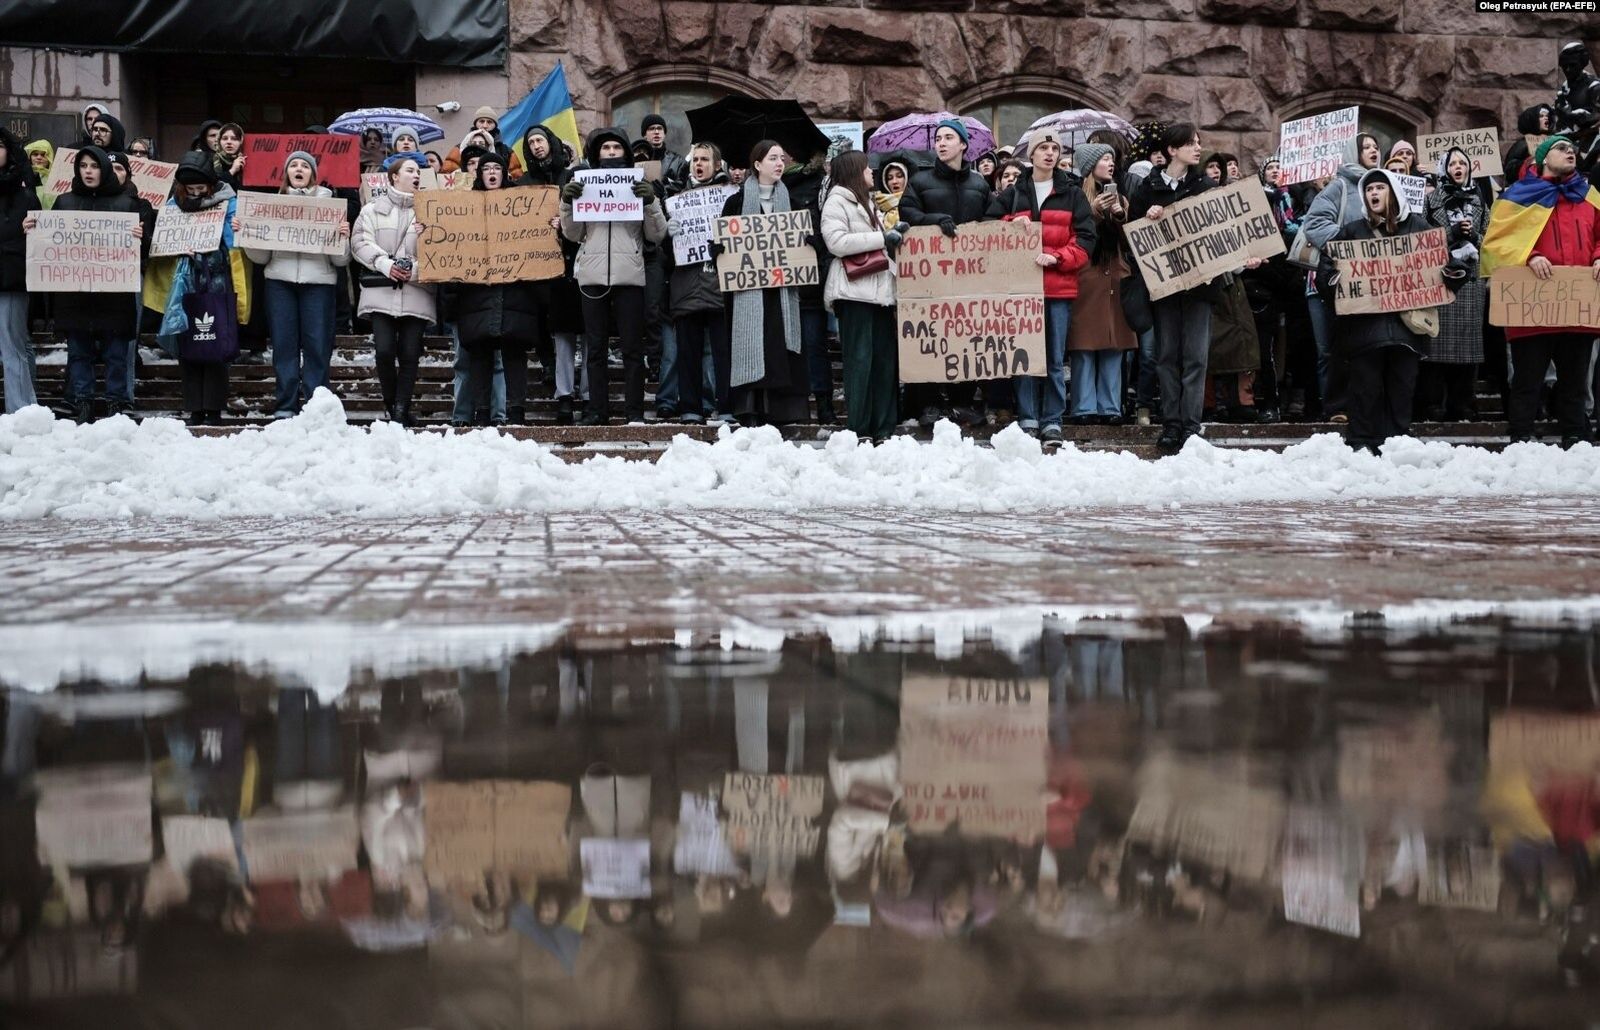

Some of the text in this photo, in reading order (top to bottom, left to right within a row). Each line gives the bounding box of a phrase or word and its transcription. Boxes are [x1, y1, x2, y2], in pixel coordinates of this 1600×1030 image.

[1284, 108, 1355, 135] НАМ НЕ ВСЕ ОДНО
[1425, 132, 1494, 148] БРУКІВКА
[1282, 150, 1300, 165] НАМ
[1313, 144, 1328, 158] ВСЕ
[1429, 151, 1440, 161] НЕ
[580, 173, 635, 185] МІЛЬЙОНИ
[599, 189, 614, 198] НА
[708, 187, 723, 196] НІЧ
[708, 194, 727, 204] СНІГ
[501, 189, 549, 218] ЗСУ!
[577, 202, 640, 213] FPV ДРОНИ
[72, 217, 133, 231] ЗУСТРІНЕ
[681, 217, 706, 227] ДЕНЬ
[717, 211, 812, 237] РОЗВ'ЯЗКИ
[1171, 191, 1252, 238] ПОДИВИСЬ
[52, 230, 133, 249] ОКУПАНТІВ
[157, 223, 216, 243] ГРОШІ НА
[242, 222, 343, 249] А НЕ СТАДІОНИ!
[424, 225, 489, 251] Дороги
[898, 227, 1041, 256] МИ НЕ РОЗУМІЄМО
[44, 246, 137, 262] ОНОВЛЕНИМ
[1142, 212, 1278, 283] У ЗАВТРАШНІЙ ДЕНЬ
[1328, 230, 1443, 260] МЕНІ ПОТРІБНІ ЖИВІ
[424, 250, 463, 271] Хочу
[740, 249, 788, 270] А НЕ
[899, 256, 987, 281] ЩО ТАКЕ
[1350, 259, 1393, 278] ХЛОПЦІ
[1405, 249, 1448, 272] ДІВЧАТА
[40, 263, 136, 283] ПАРКАНОМ?
[723, 265, 818, 290] РОЗВ'ЯЗКИ
[1337, 282, 1345, 299] А
[1349, 281, 1364, 299] НЕ
[1369, 272, 1426, 297] БРУКІВКА
[929, 297, 1044, 321] БЛАГОУСТРІЙ
[1506, 301, 1568, 326] ГРОШІ
[192, 332, 217, 341] adidas
[902, 320, 938, 339] АЛЕ
[920, 335, 1017, 359] ЩО ТАКЕ
[944, 347, 1030, 381] ВІЙНА
